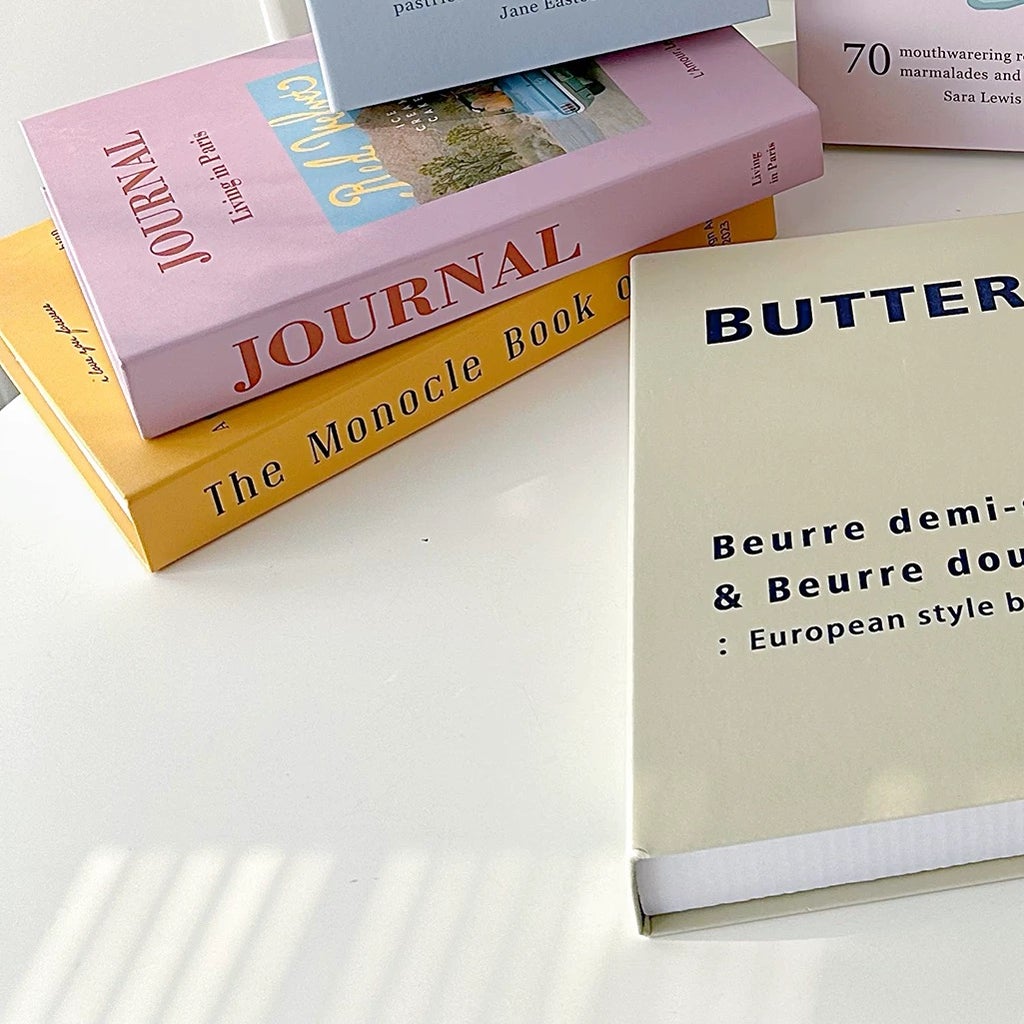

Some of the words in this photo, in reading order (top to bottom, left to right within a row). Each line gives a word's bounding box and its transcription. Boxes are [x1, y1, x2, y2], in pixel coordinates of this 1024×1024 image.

[499, 1, 540, 20] Jane
[843, 42, 892, 75] 70
[899, 46, 1012, 64] mouthwarering
[899, 66, 988, 81] marmalades
[994, 69, 1022, 82] and
[943, 90, 976, 103] Sara
[980, 91, 1022, 104] Lewis
[386, 110, 406, 128] ICE
[190, 130, 221, 166] Paris
[767, 141, 779, 172] Paris
[210, 164, 231, 182] in
[752, 152, 763, 187] Living
[769, 173, 779, 185] in
[103, 129, 212, 274] JOURNAL
[221, 176, 254, 225] Living
[232, 223, 582, 394] JOURNAL
[203, 457, 285, 517] The
[306, 355, 483, 465] Monocle
[503, 292, 597, 362] Book
[712, 519, 866, 561] Beurre
[713, 583, 743, 612] &
[768, 561, 924, 604] Beurre
[749, 609, 906, 651] European
[918, 596, 995, 629] style
